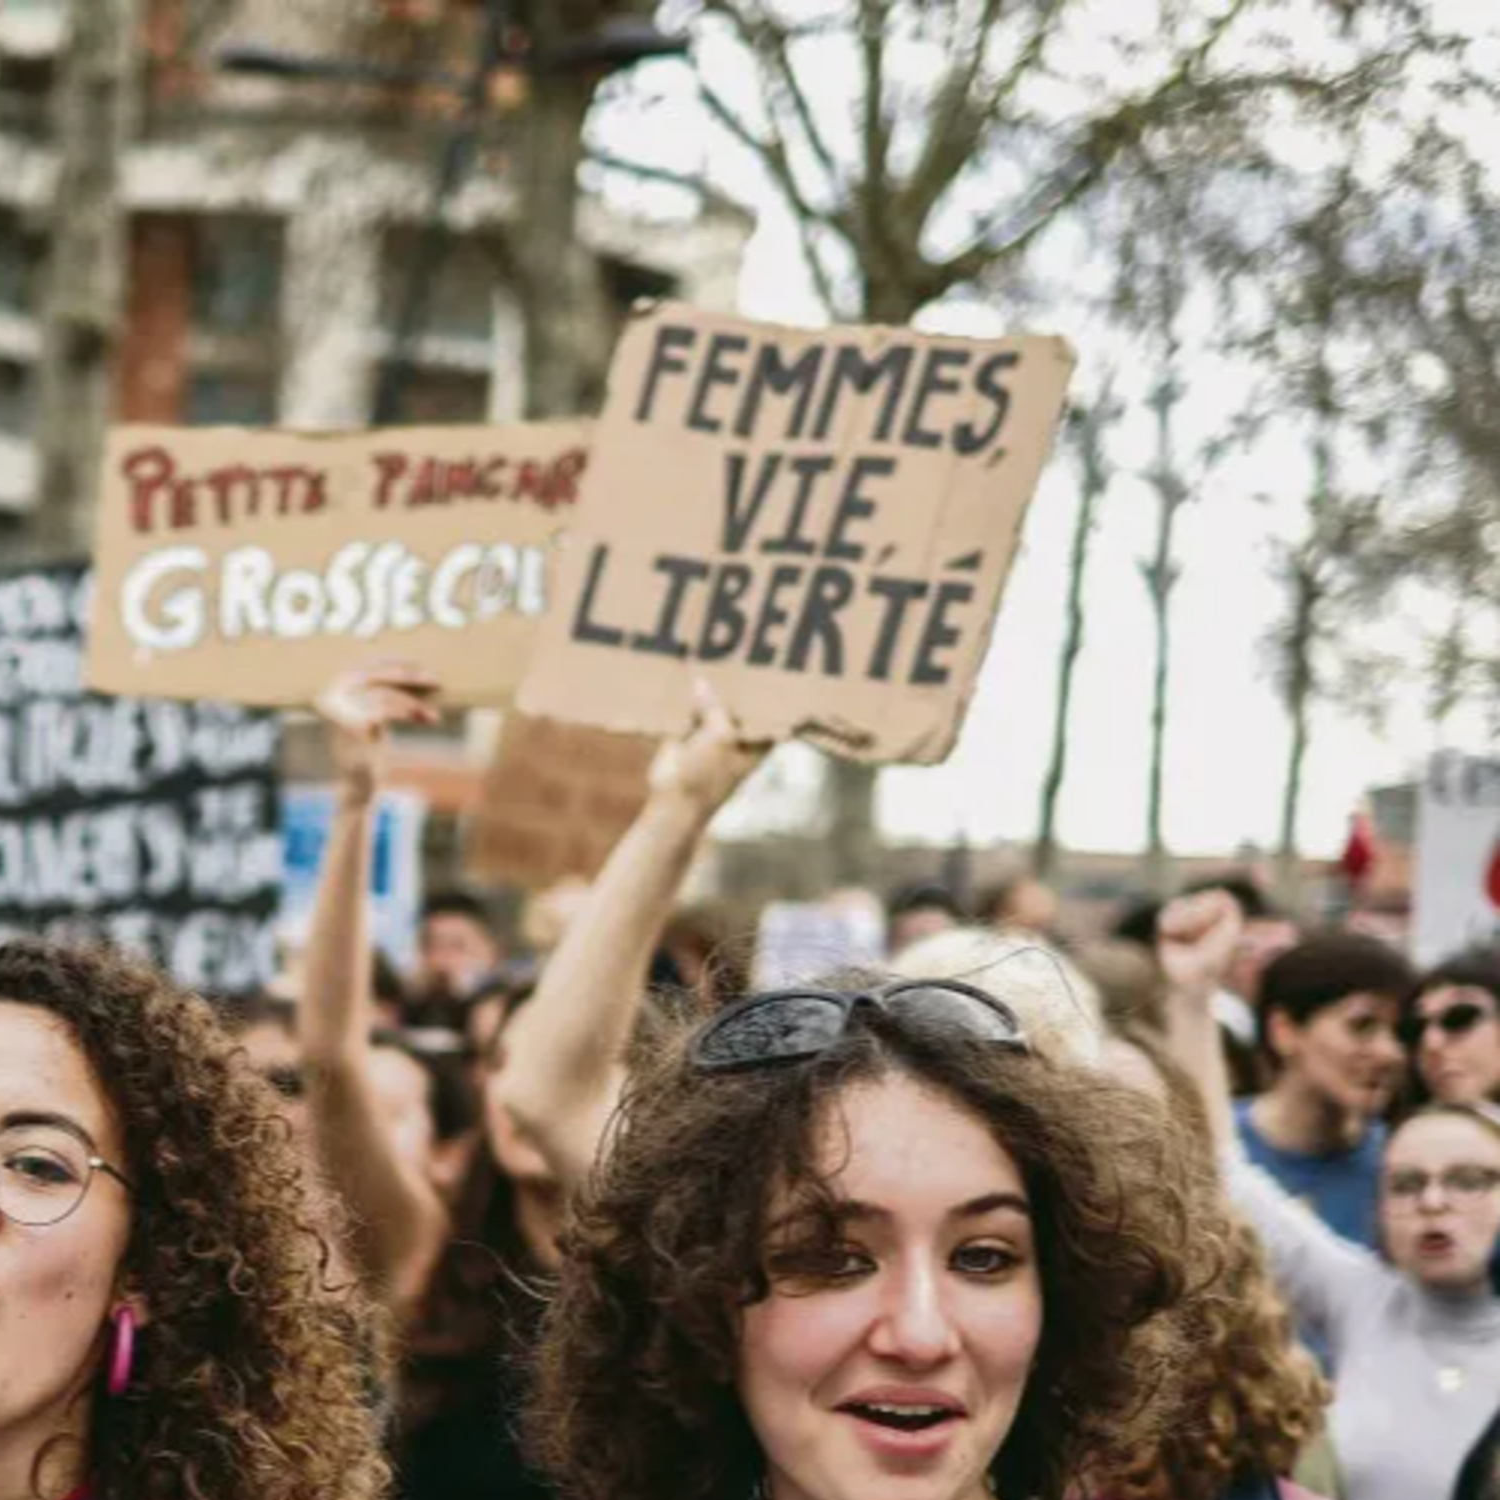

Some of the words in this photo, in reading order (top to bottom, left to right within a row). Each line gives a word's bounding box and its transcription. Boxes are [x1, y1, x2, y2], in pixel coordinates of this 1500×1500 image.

[633, 325, 1020, 469] FEMMES,
[719, 451, 898, 567] VIE,
[570, 543, 984, 686] LIBERTÉ
